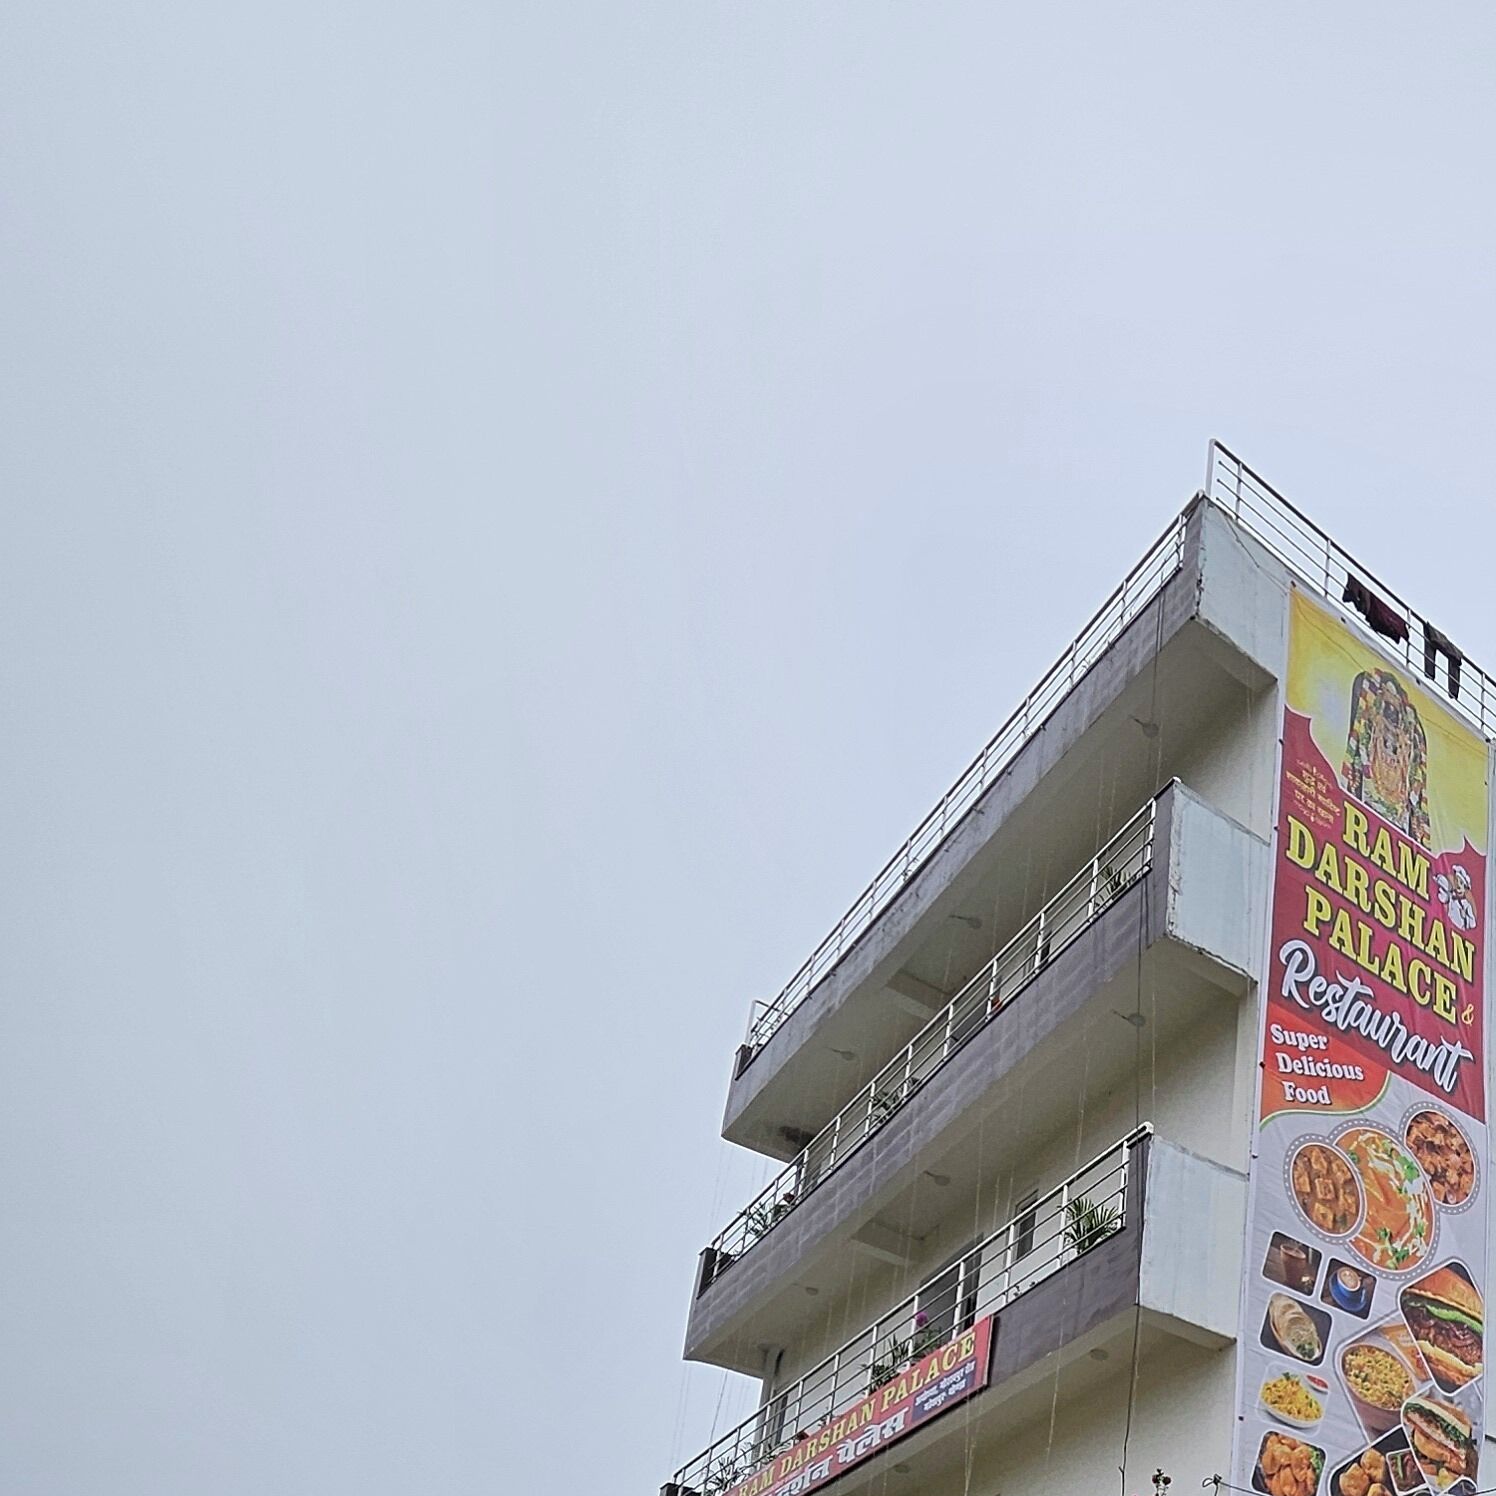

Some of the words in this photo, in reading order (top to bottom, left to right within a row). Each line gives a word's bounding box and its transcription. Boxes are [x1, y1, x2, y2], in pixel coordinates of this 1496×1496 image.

[1286, 815, 1475, 983] DARSHAN
[1342, 801, 1430, 900] RAM
[1303, 885, 1457, 1025] PALACE
[1270, 1023, 1328, 1051] Super
[1279, 939, 1474, 1093] Restaurant
[1275, 1052, 1364, 1080] Delicious
[1282, 1081, 1331, 1105] Food
[780, 1398, 876, 1478] DARSHAN
[881, 1332, 976, 1412] PALACE
[836, 1407, 909, 1463] पैलेस
